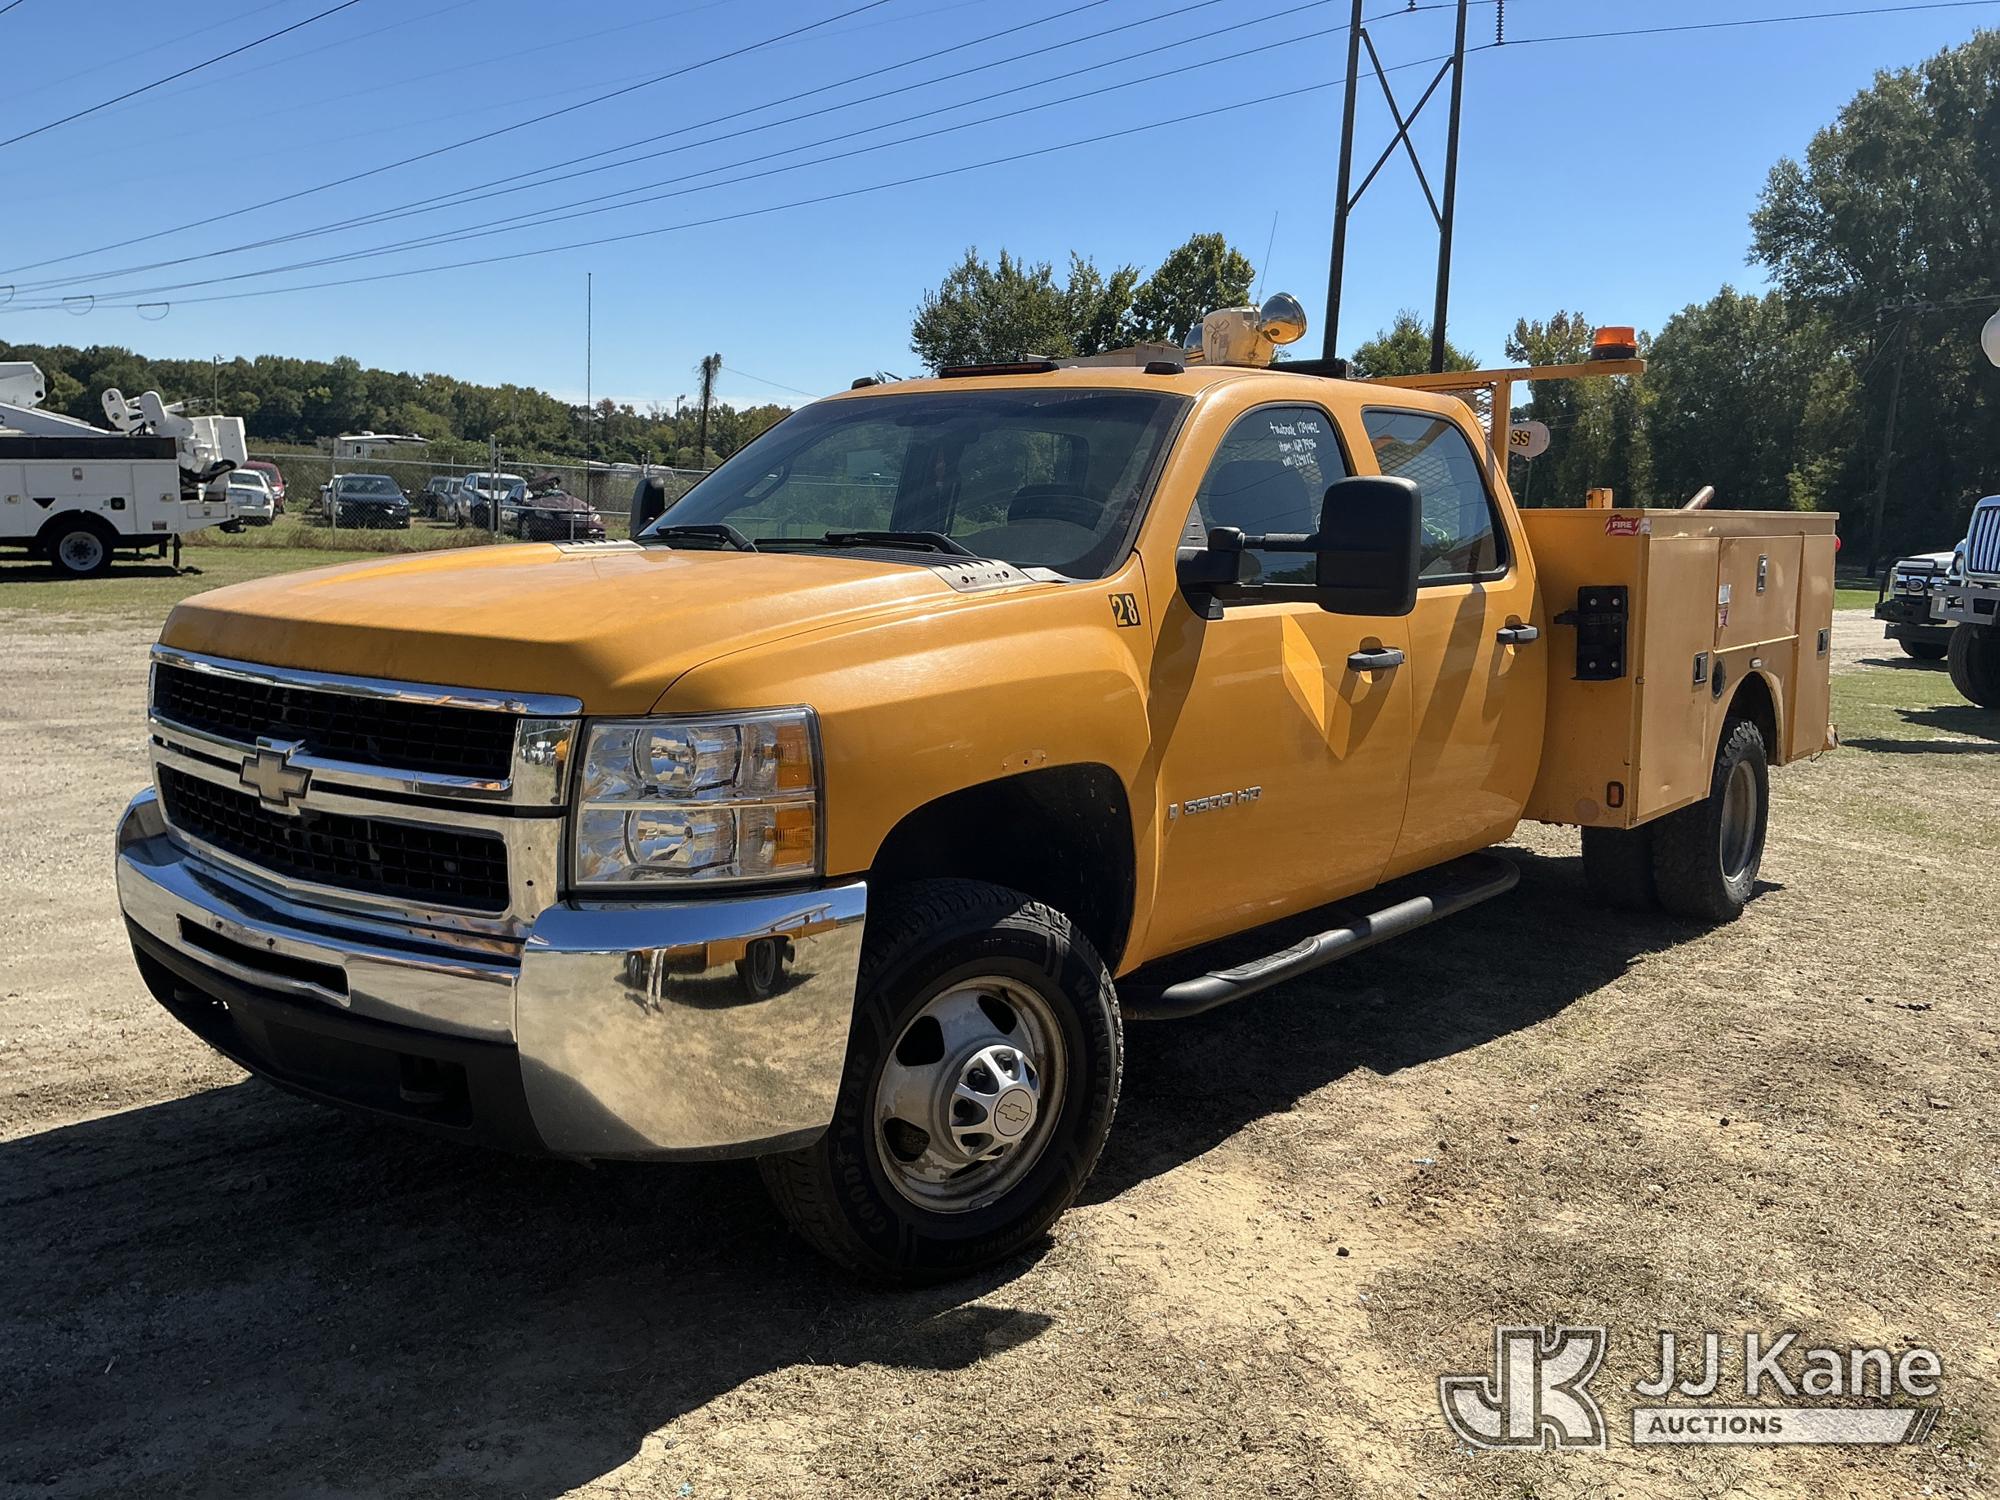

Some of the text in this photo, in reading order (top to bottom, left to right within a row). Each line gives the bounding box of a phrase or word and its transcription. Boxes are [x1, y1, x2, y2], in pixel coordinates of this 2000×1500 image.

[1612, 520, 1633, 529] FIRE
[1111, 594, 1138, 625] 28
[1235, 785, 1262, 804] HD
